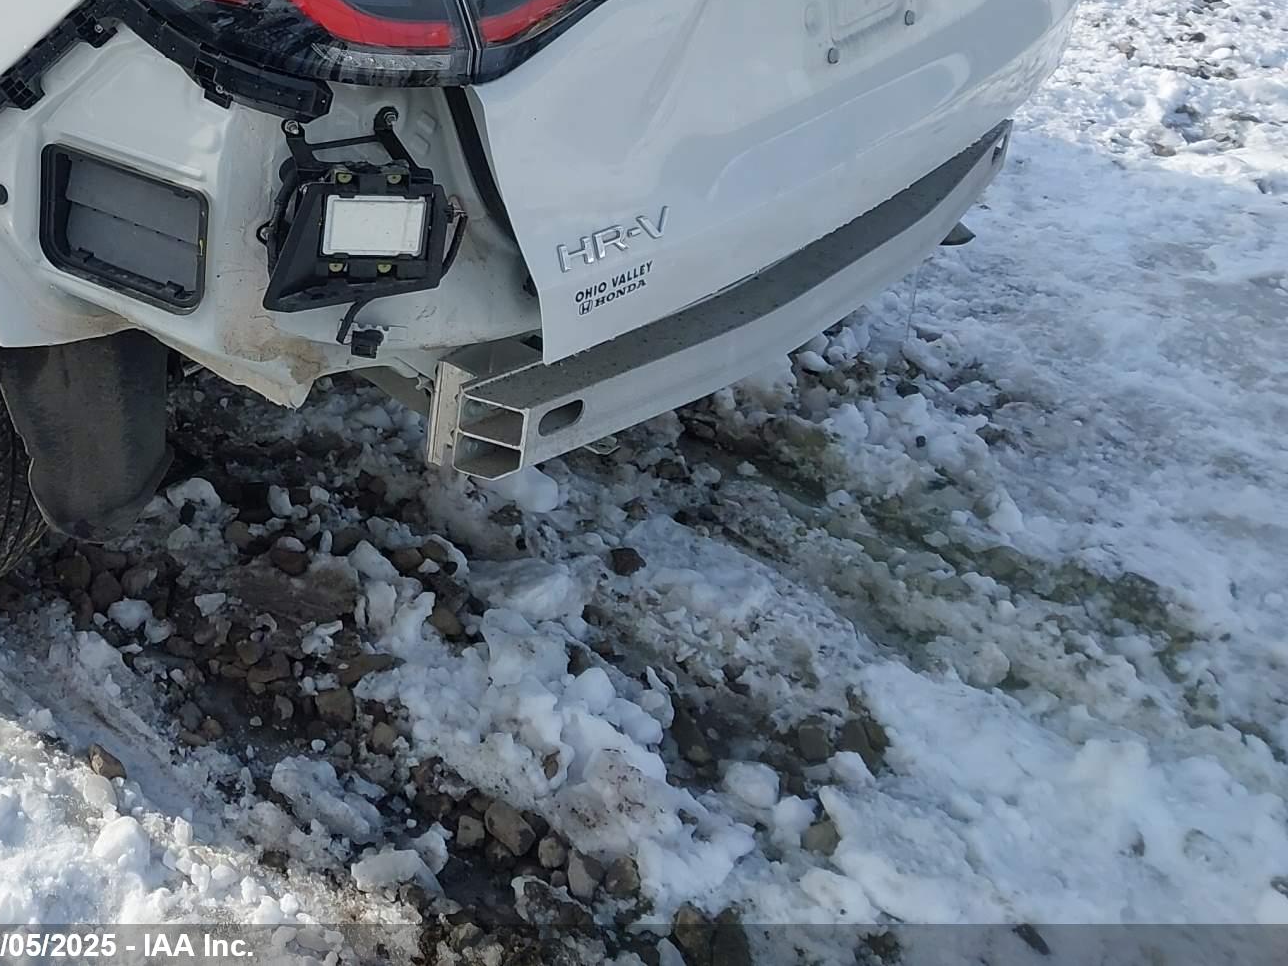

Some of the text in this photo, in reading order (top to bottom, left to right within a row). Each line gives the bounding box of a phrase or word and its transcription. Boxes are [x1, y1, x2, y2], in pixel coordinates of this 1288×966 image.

[557, 205, 671, 273] HR-V
[575, 260, 653, 302] OHIO VALLEY
[594, 279, 646, 307] HONDA
